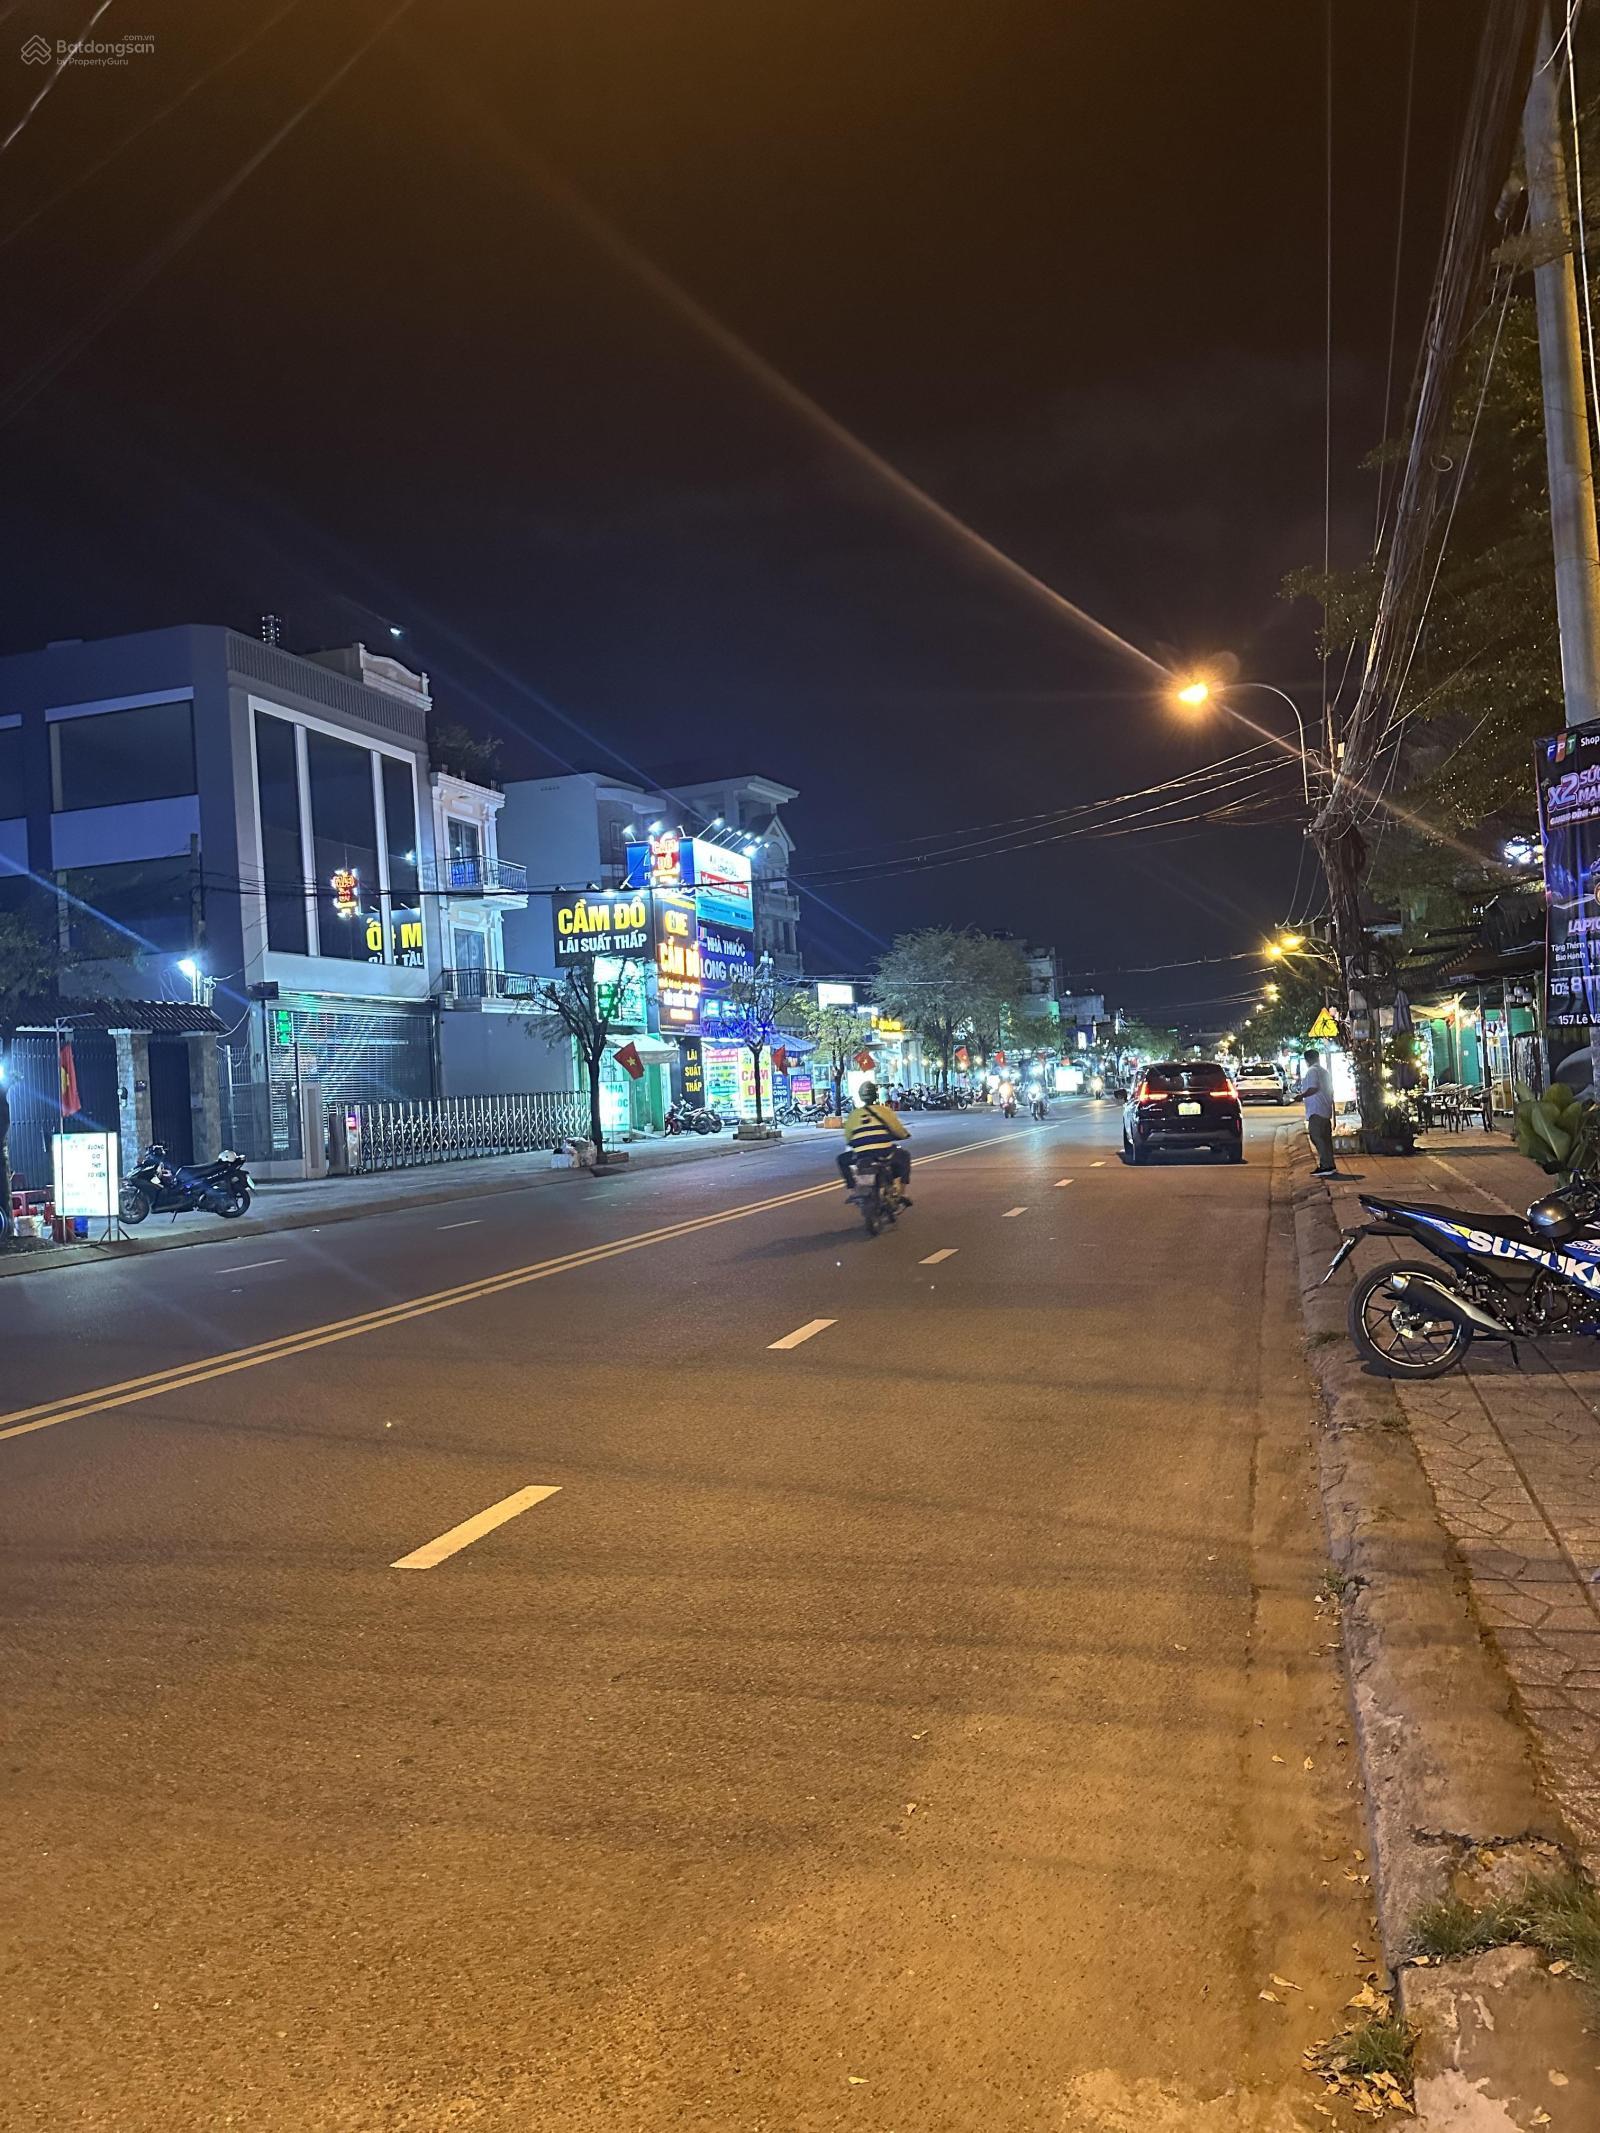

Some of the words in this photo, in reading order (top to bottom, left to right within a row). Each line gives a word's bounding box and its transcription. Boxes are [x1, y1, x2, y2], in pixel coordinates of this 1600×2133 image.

[1547, 736, 1576, 759] FPT
[1580, 735, 1600, 748] Shop
[558, 898, 610, 935] CẦM
[559, 936, 579, 954] LÃI
[580, 932, 612, 953] SUẤT
[613, 929, 647, 950] THẤP
[707, 935, 723, 954] NHÀ
[722, 937, 746, 958] THUỐC
[700, 958, 727, 981] LONG
[1558, 1014, 1574, 1025] 157
[1576, 1013, 1589, 1025] Lê
[685, 1063, 701, 1077] SUẤT
[685, 1080, 703, 1092] THẤP
